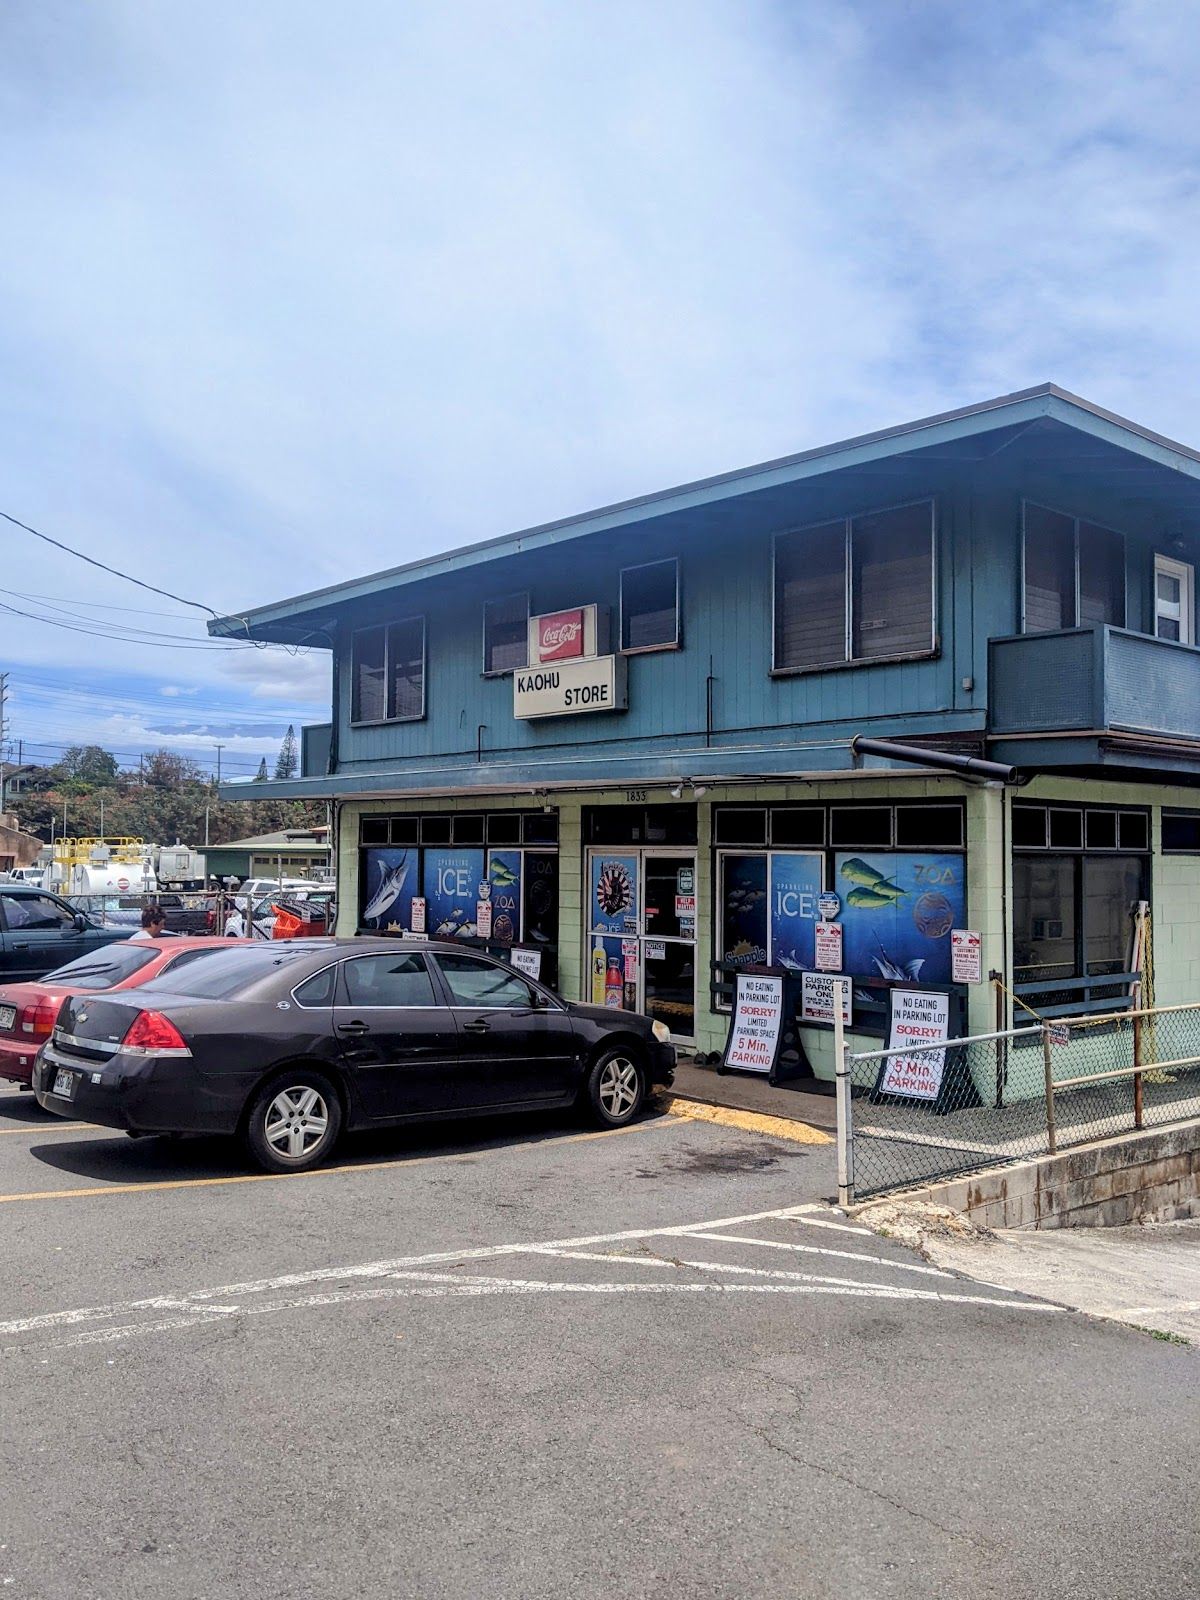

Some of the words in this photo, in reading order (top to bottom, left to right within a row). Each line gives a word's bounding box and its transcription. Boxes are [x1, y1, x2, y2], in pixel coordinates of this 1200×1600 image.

[518, 672, 560, 693] KAOHU
[564, 685, 608, 706] STORE
[438, 868, 468, 897] ICE
[494, 896, 515, 909] ZOA
[777, 891, 813, 918] ICE
[725, 945, 766, 964] Snapple
[746, 981, 754, 991] NO
[755, 983, 774, 992] EATING
[805, 983, 849, 994] PARKIG
[739, 992, 745, 1001] IN
[745, 993, 769, 1003] PARKING
[770, 995, 780, 1004] LOT
[815, 990, 834, 999] ONL
[903, 997, 913, 1007] NO
[914, 999, 938, 1010] EATING
[740, 1006, 777, 1018] SORRY!
[893, 1009, 901, 1019] IN
[903, 1010, 932, 1022] PARKING
[933, 1013, 947, 1024] LOT
[747, 1018, 768, 1028] LIMITED
[736, 1027, 759, 1038] PARKING
[759, 1029, 776, 1039] SPACE
[896, 1024, 943, 1038] SORRY!
[738, 1038, 745, 1049] 5
[747, 1038, 769, 1052] Min.
[731, 1051, 771, 1065] PARKING
[921, 1051, 941, 1062] SPACE
[895, 1060, 902, 1073] 5
[887, 1075, 936, 1092] PARKING
